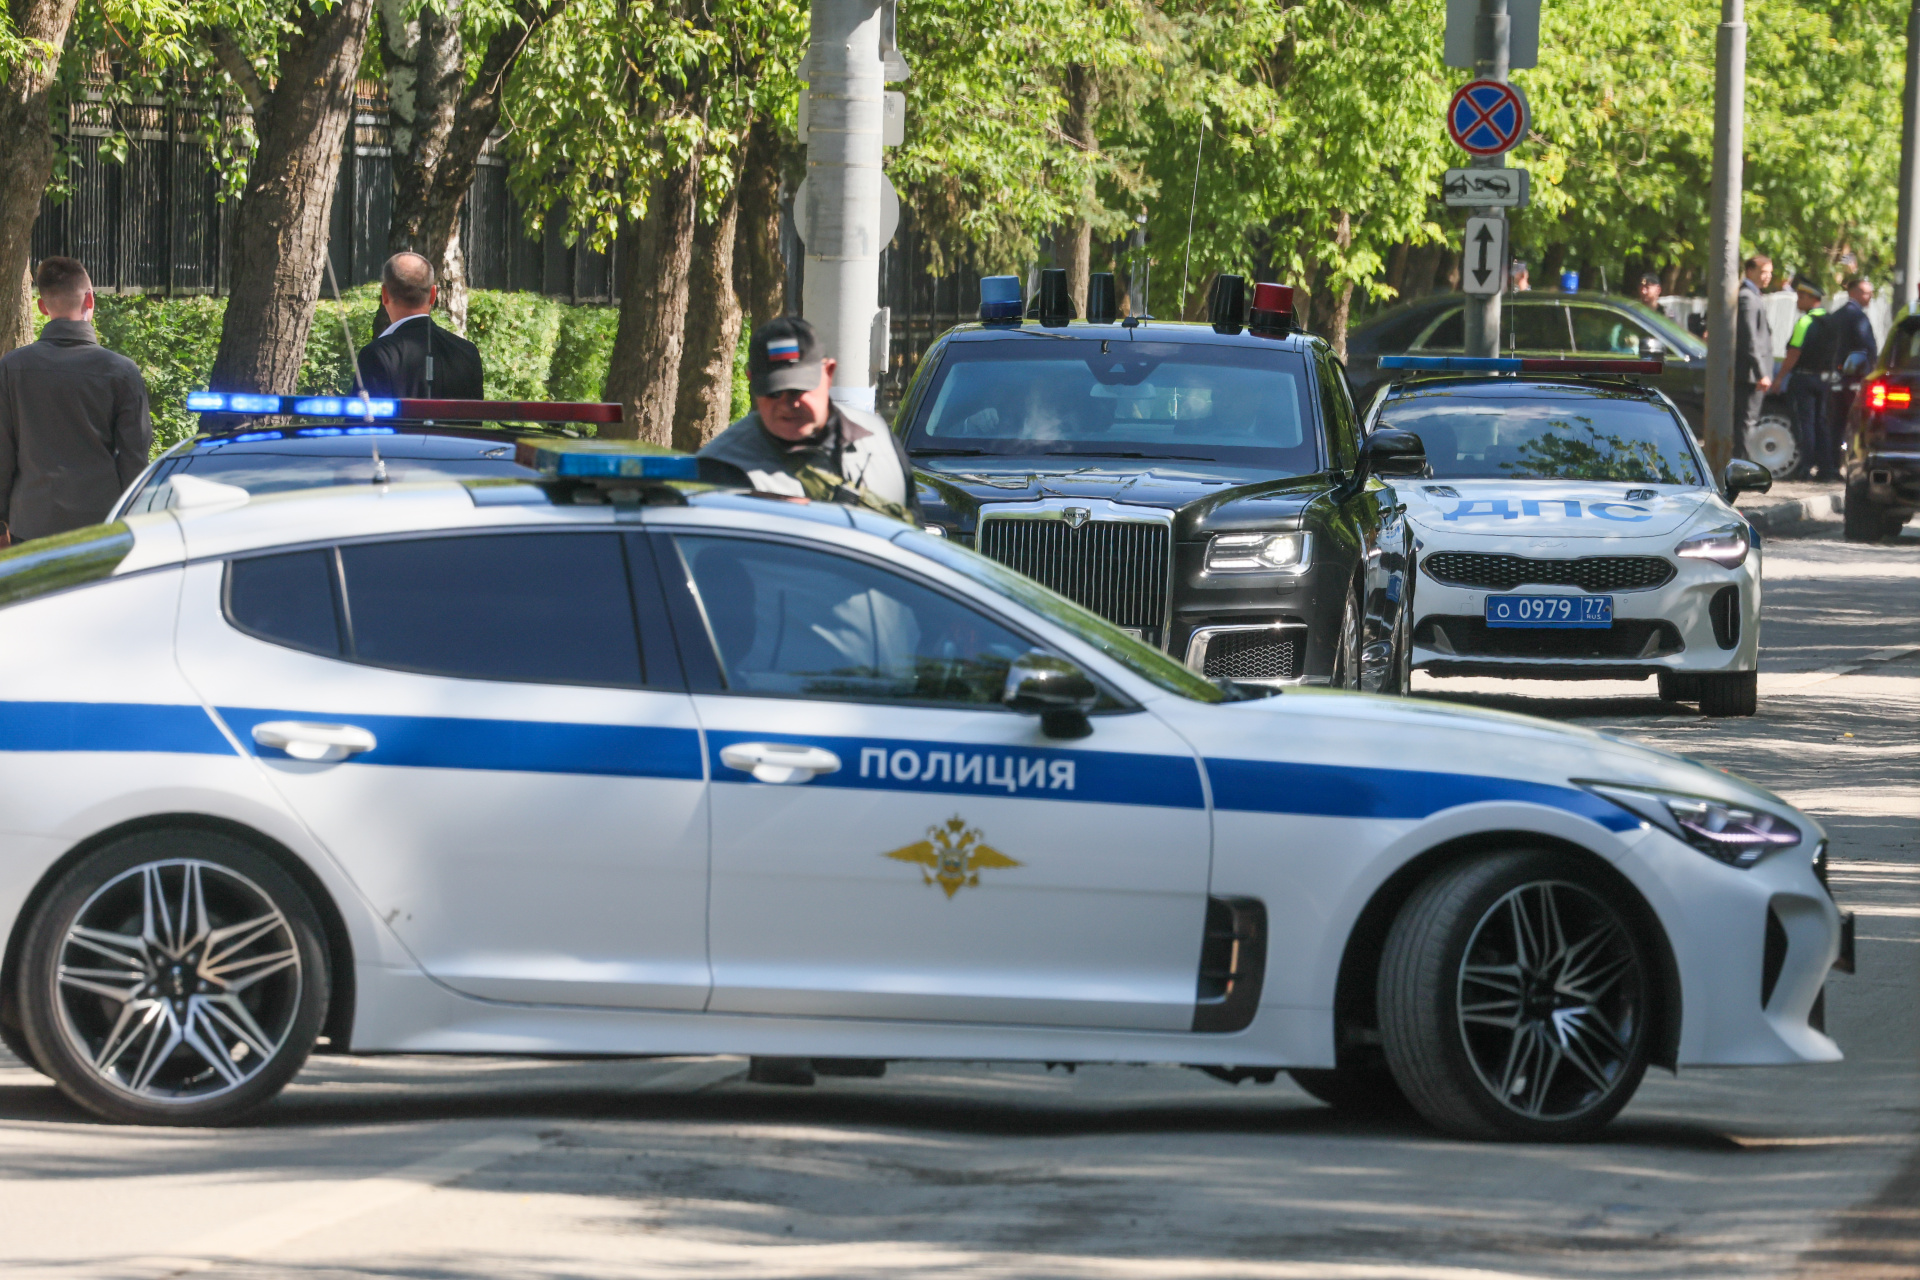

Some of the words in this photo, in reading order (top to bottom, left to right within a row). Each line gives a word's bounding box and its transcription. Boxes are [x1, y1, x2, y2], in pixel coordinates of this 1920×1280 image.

[1443, 500, 1653, 522] ДПС
[1519, 599, 1572, 619] 0979
[1584, 599, 1604, 613] 77
[859, 747, 1075, 792] ПОЛИЦИЯ
